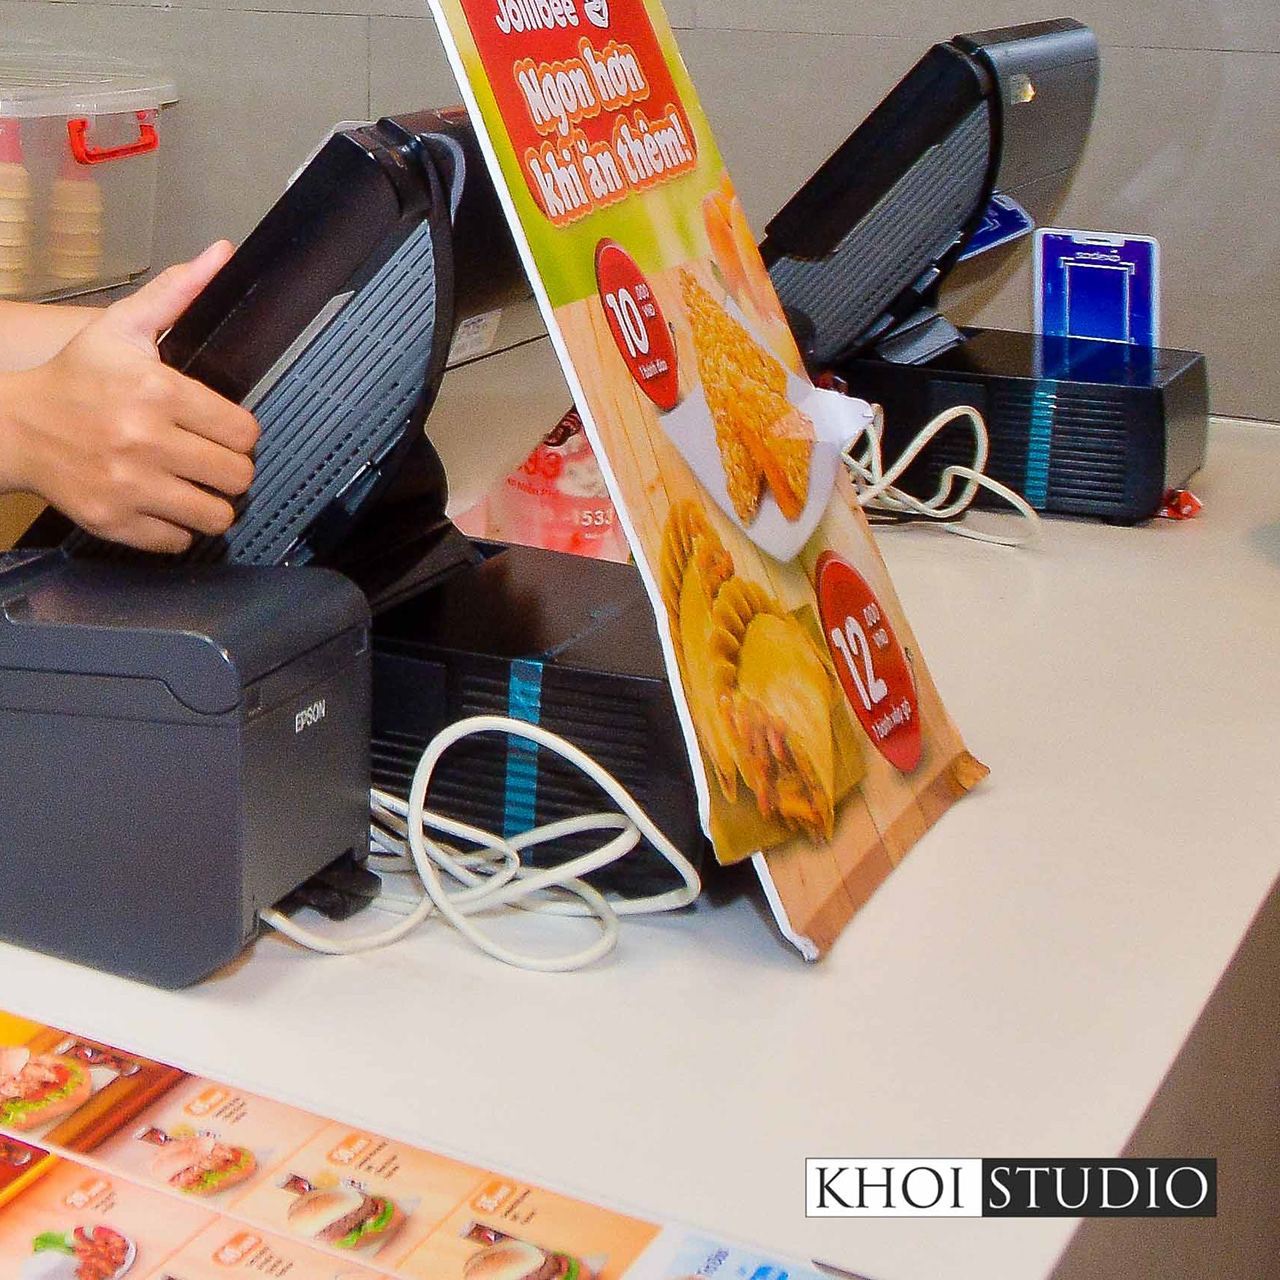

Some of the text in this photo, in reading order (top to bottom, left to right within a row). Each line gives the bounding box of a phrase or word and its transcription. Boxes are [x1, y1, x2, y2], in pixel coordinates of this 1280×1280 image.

[518, 46, 645, 137] Ngon hơn
[529, 112, 693, 218] khi ăn thêm!
[605, 287, 650, 359] 10
[830, 615, 888, 712] 12
[295, 698, 326, 734] EPSON
